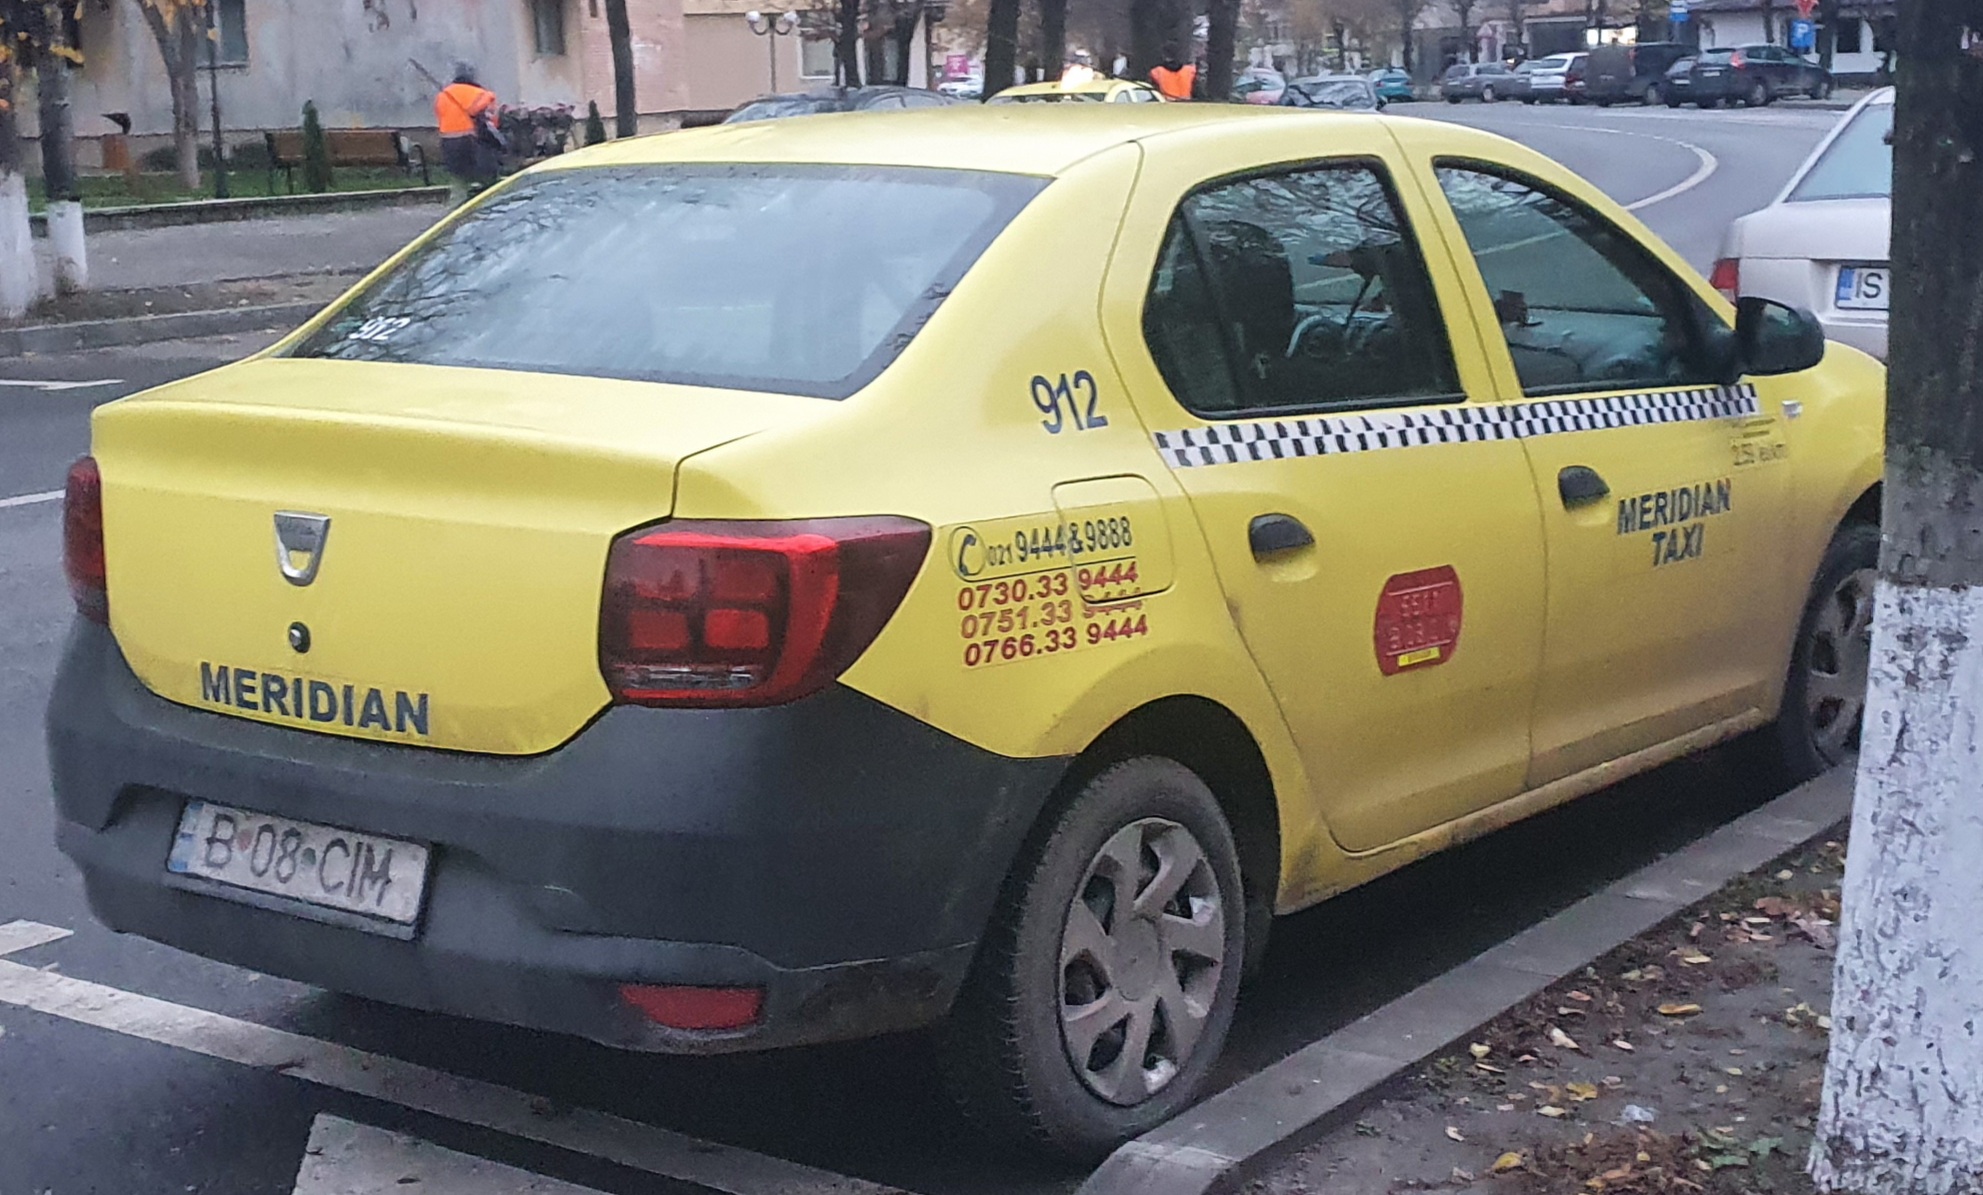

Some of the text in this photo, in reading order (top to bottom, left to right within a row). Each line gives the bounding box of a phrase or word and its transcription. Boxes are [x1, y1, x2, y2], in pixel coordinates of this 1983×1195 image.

[1031, 369, 1109, 434] 912
[1617, 477, 1732, 535] MERIDIAN
[1652, 523, 1704, 567] TAXI
[957, 561, 1138, 611] 0730.33 9444
[961, 600, 1072, 639] 0751.33
[964, 614, 1148, 667] 0766.33 9444
[200, 661, 429, 735] MERIDIAN
[205, 813, 236, 868] B
[250, 823, 302, 884] 08
